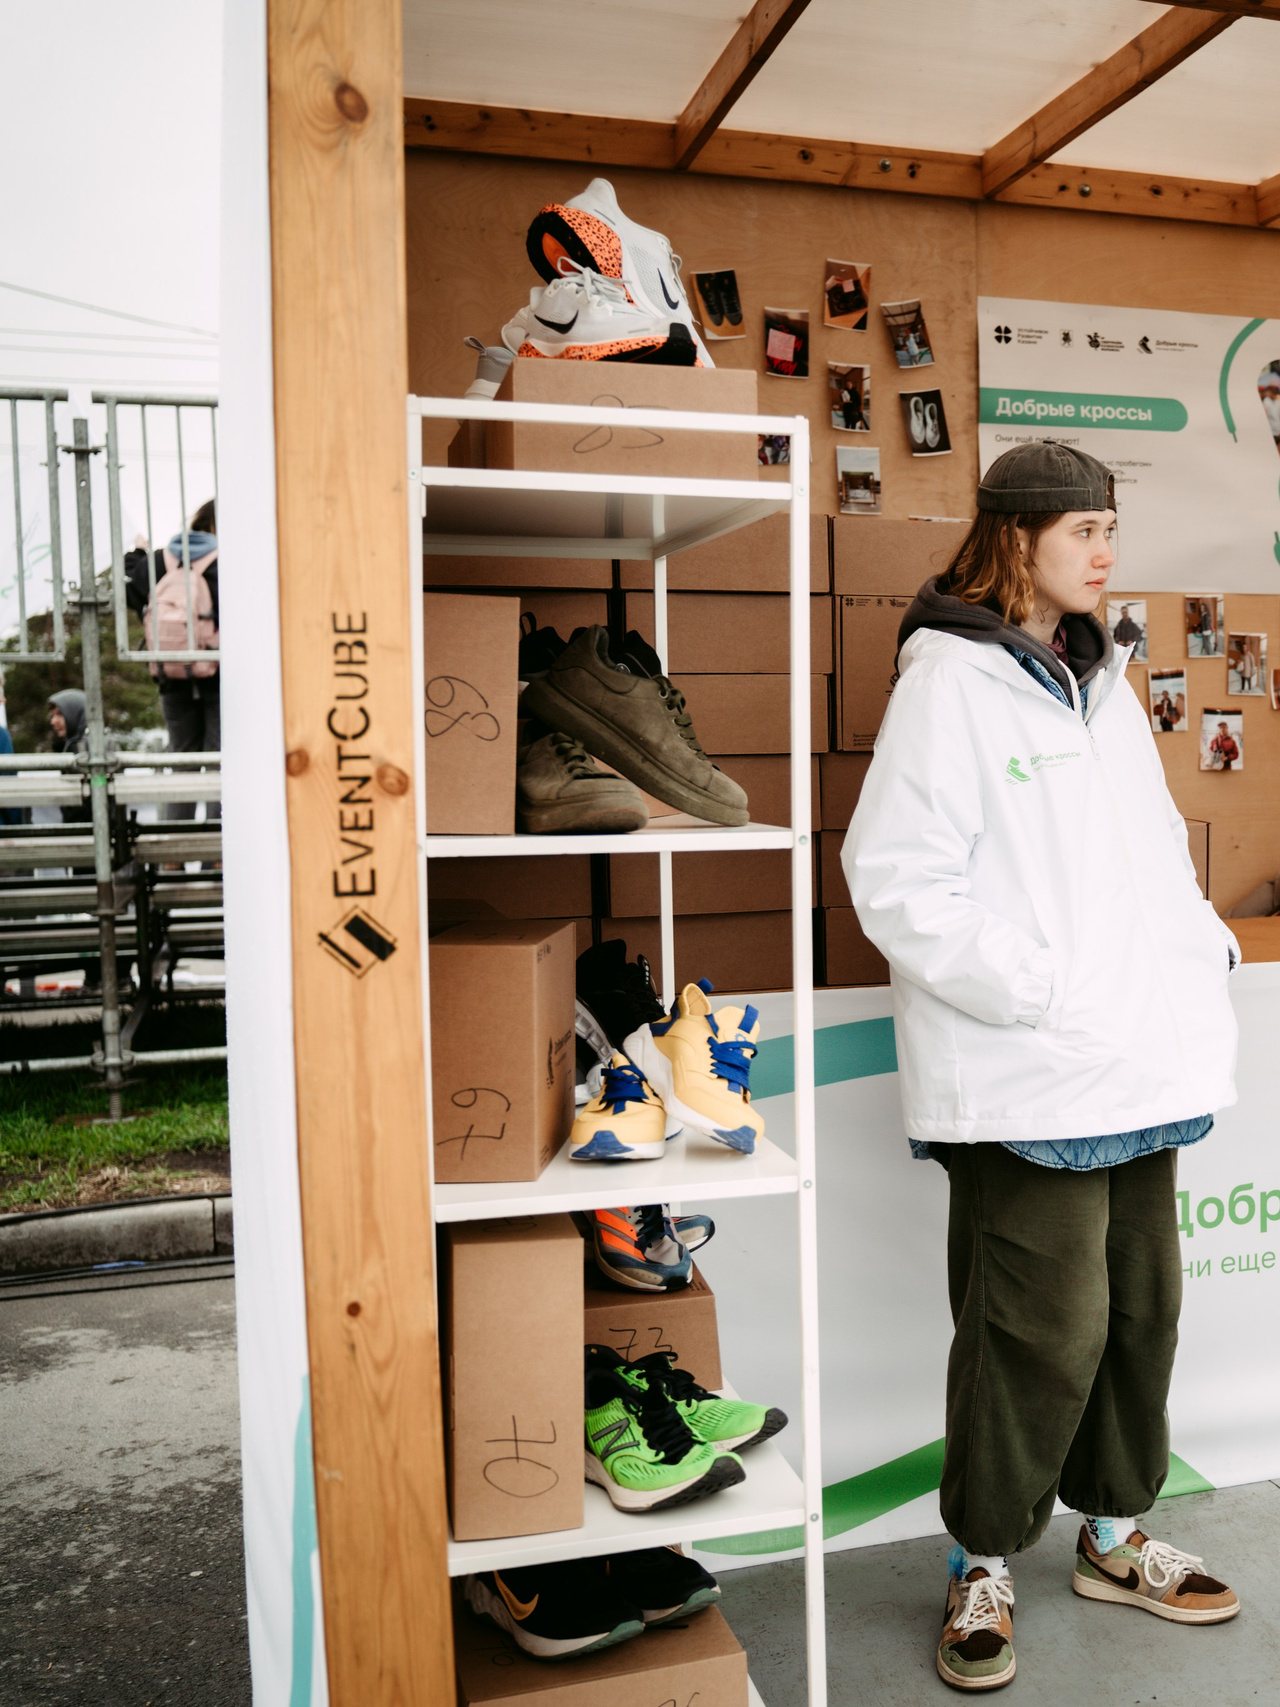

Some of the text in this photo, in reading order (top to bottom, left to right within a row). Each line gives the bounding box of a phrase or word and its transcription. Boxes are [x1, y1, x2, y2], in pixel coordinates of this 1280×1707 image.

[995, 397, 1153, 422] Добрые кроссы
[994, 434, 1013, 443] Они
[1181, 1258, 1212, 1278] ни
[1220, 1251, 1277, 1274] еще
[483, 1413, 559, 1498] 70
